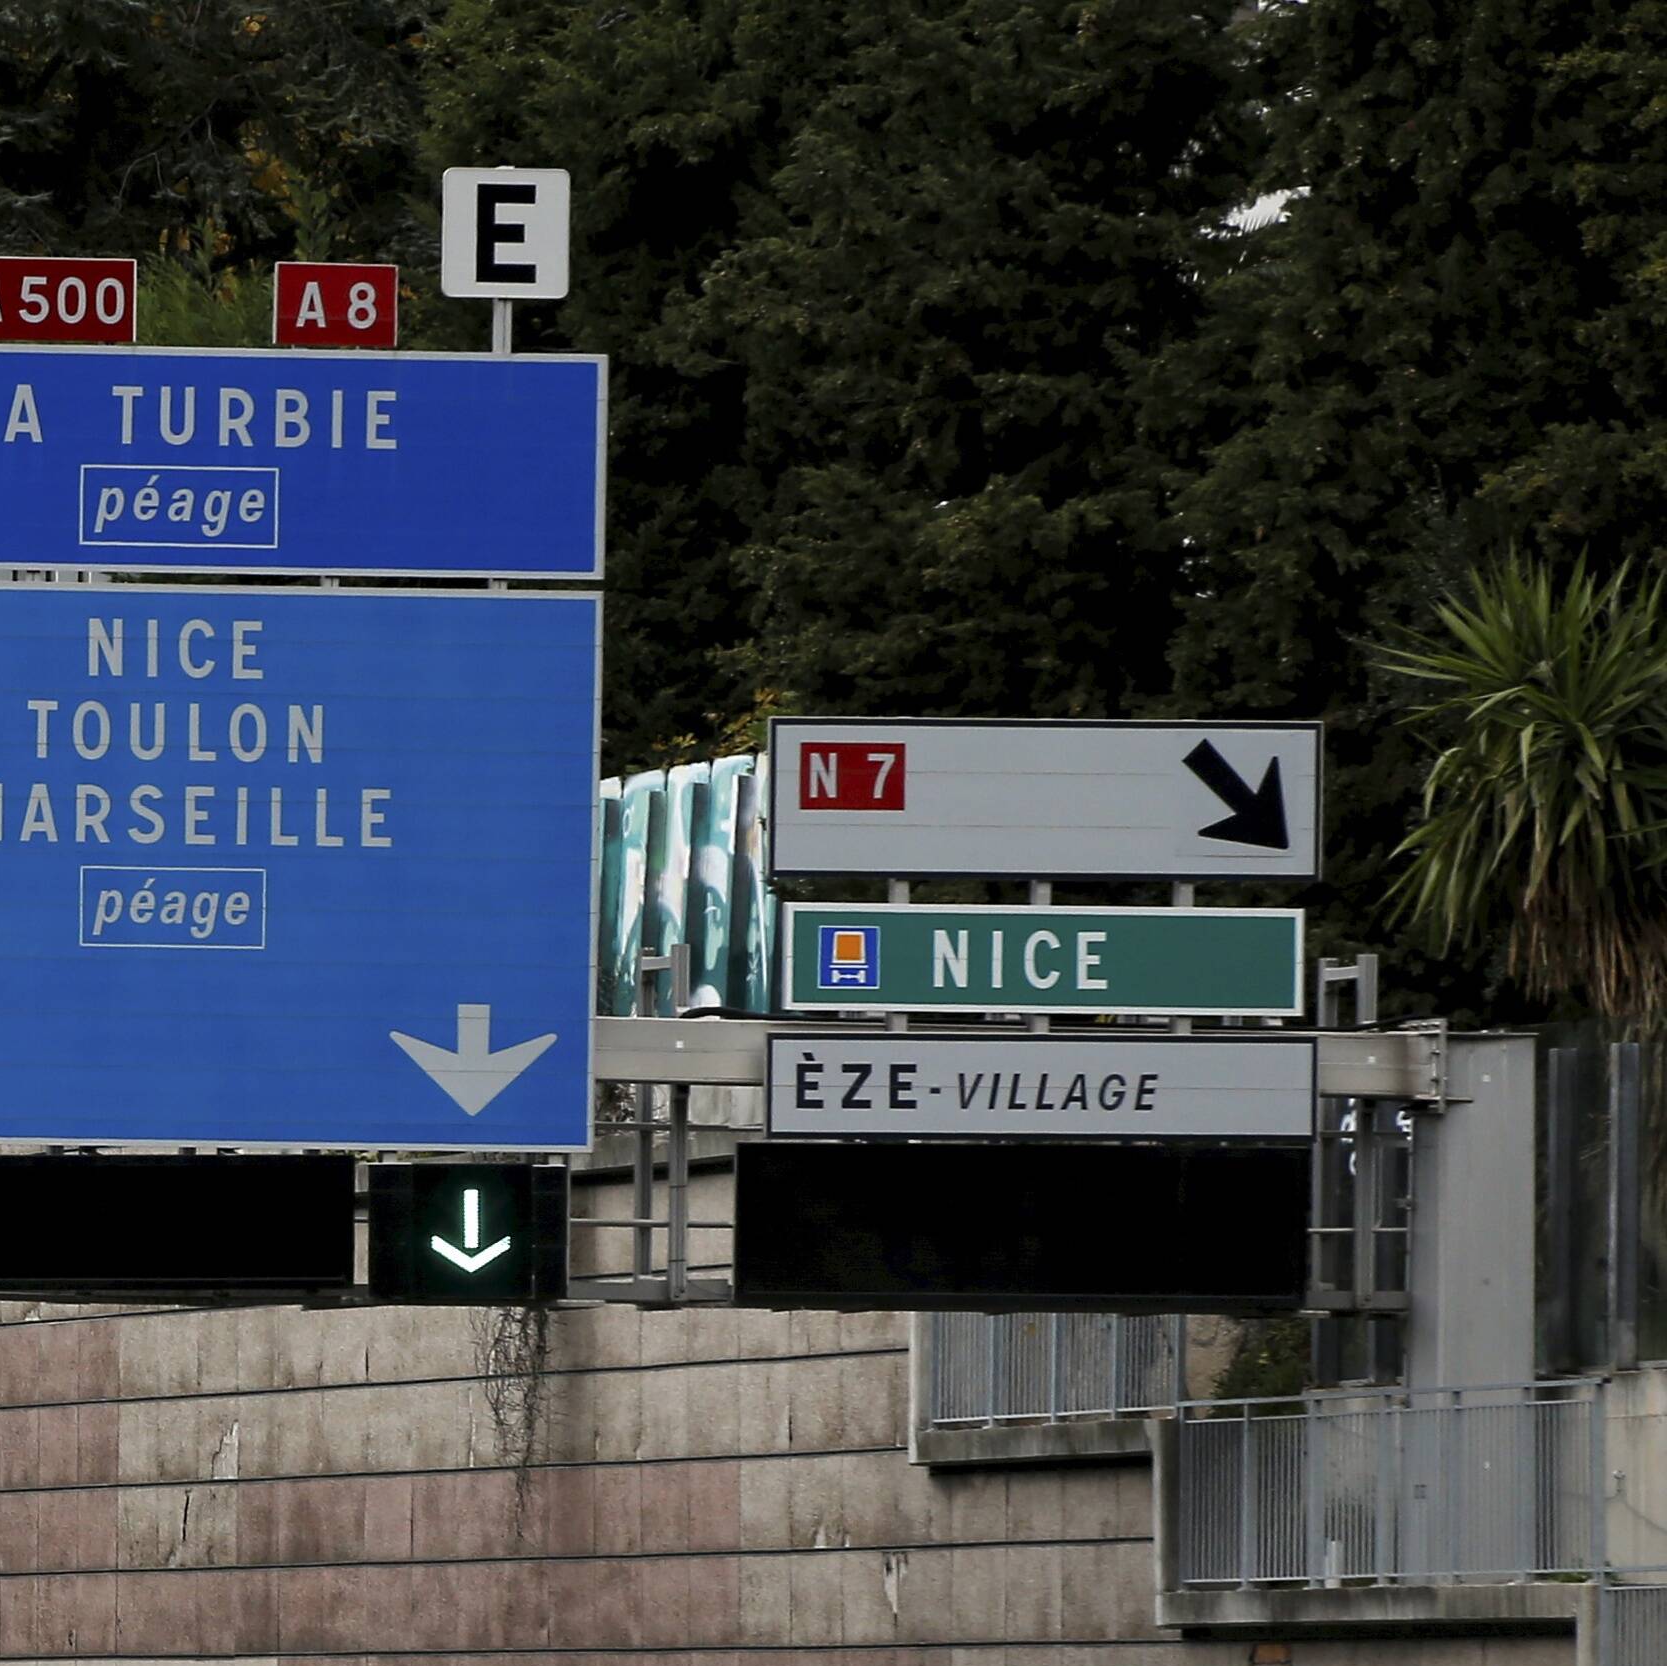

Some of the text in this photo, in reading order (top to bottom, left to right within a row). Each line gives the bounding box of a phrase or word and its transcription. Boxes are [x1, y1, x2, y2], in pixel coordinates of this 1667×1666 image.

[476, 184, 537, 284] E
[111, 386, 398, 450] TURBIE
[94, 474, 266, 537] péage
[87, 618, 264, 680] NICE
[27, 700, 324, 764] TOULON
[92, 877, 250, 939] péage
[932, 929, 1109, 990] NICE
